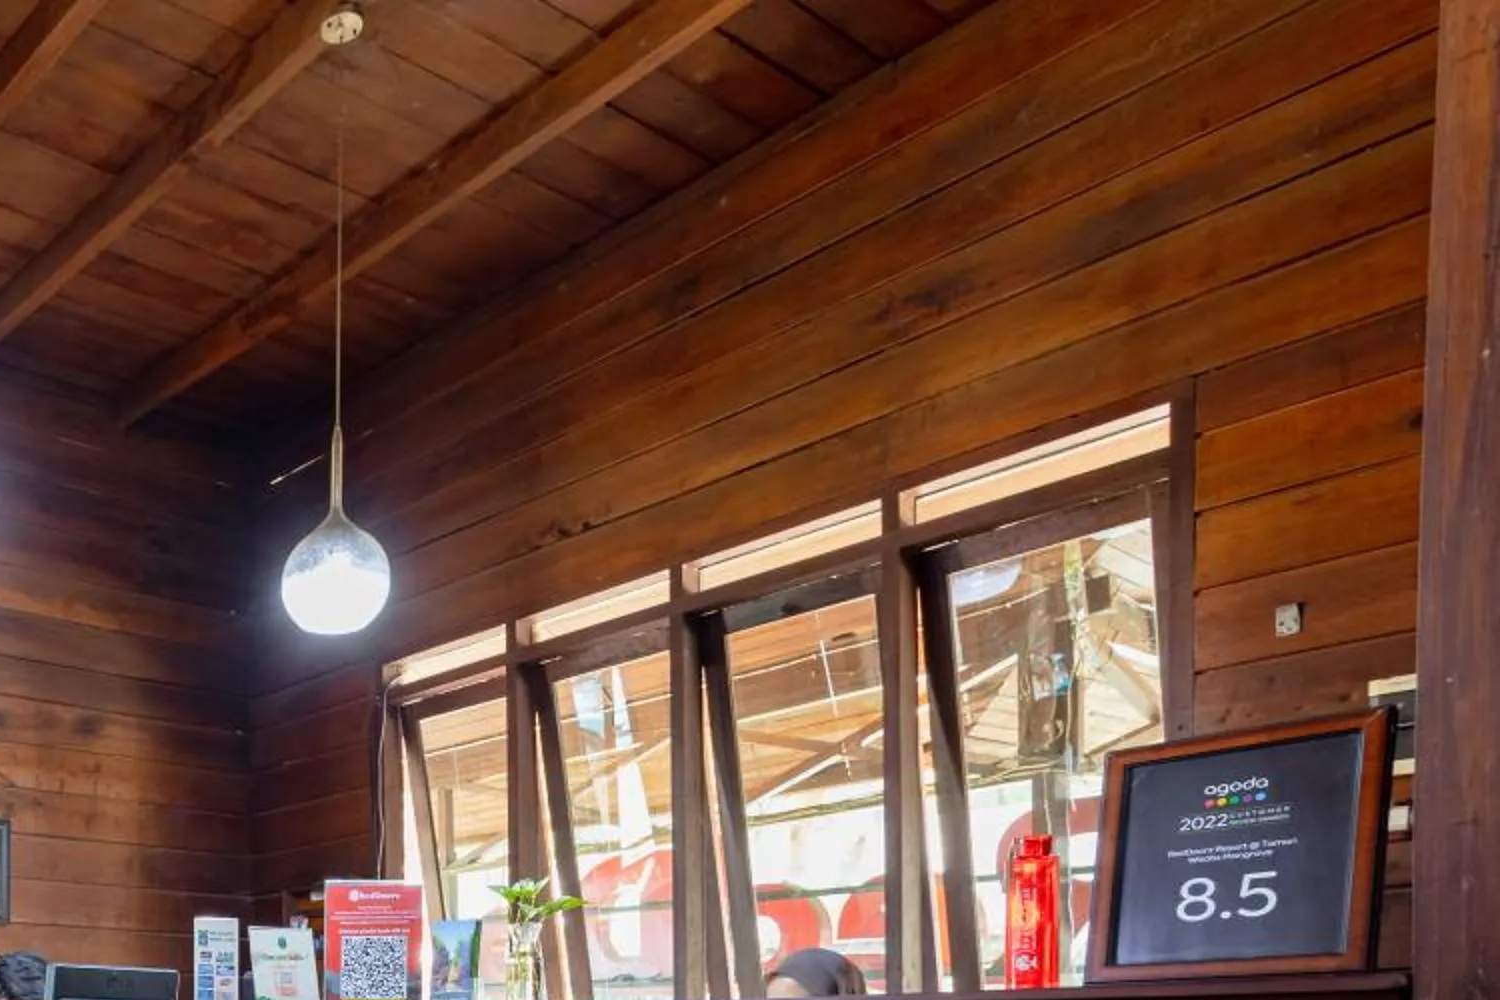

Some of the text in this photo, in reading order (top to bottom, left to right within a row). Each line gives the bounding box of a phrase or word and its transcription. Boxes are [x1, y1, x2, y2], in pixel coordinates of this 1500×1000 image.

[1203, 776, 1269, 797] agoda
[1179, 813, 1229, 832] 2022
[1175, 870, 1279, 922] 8.5
